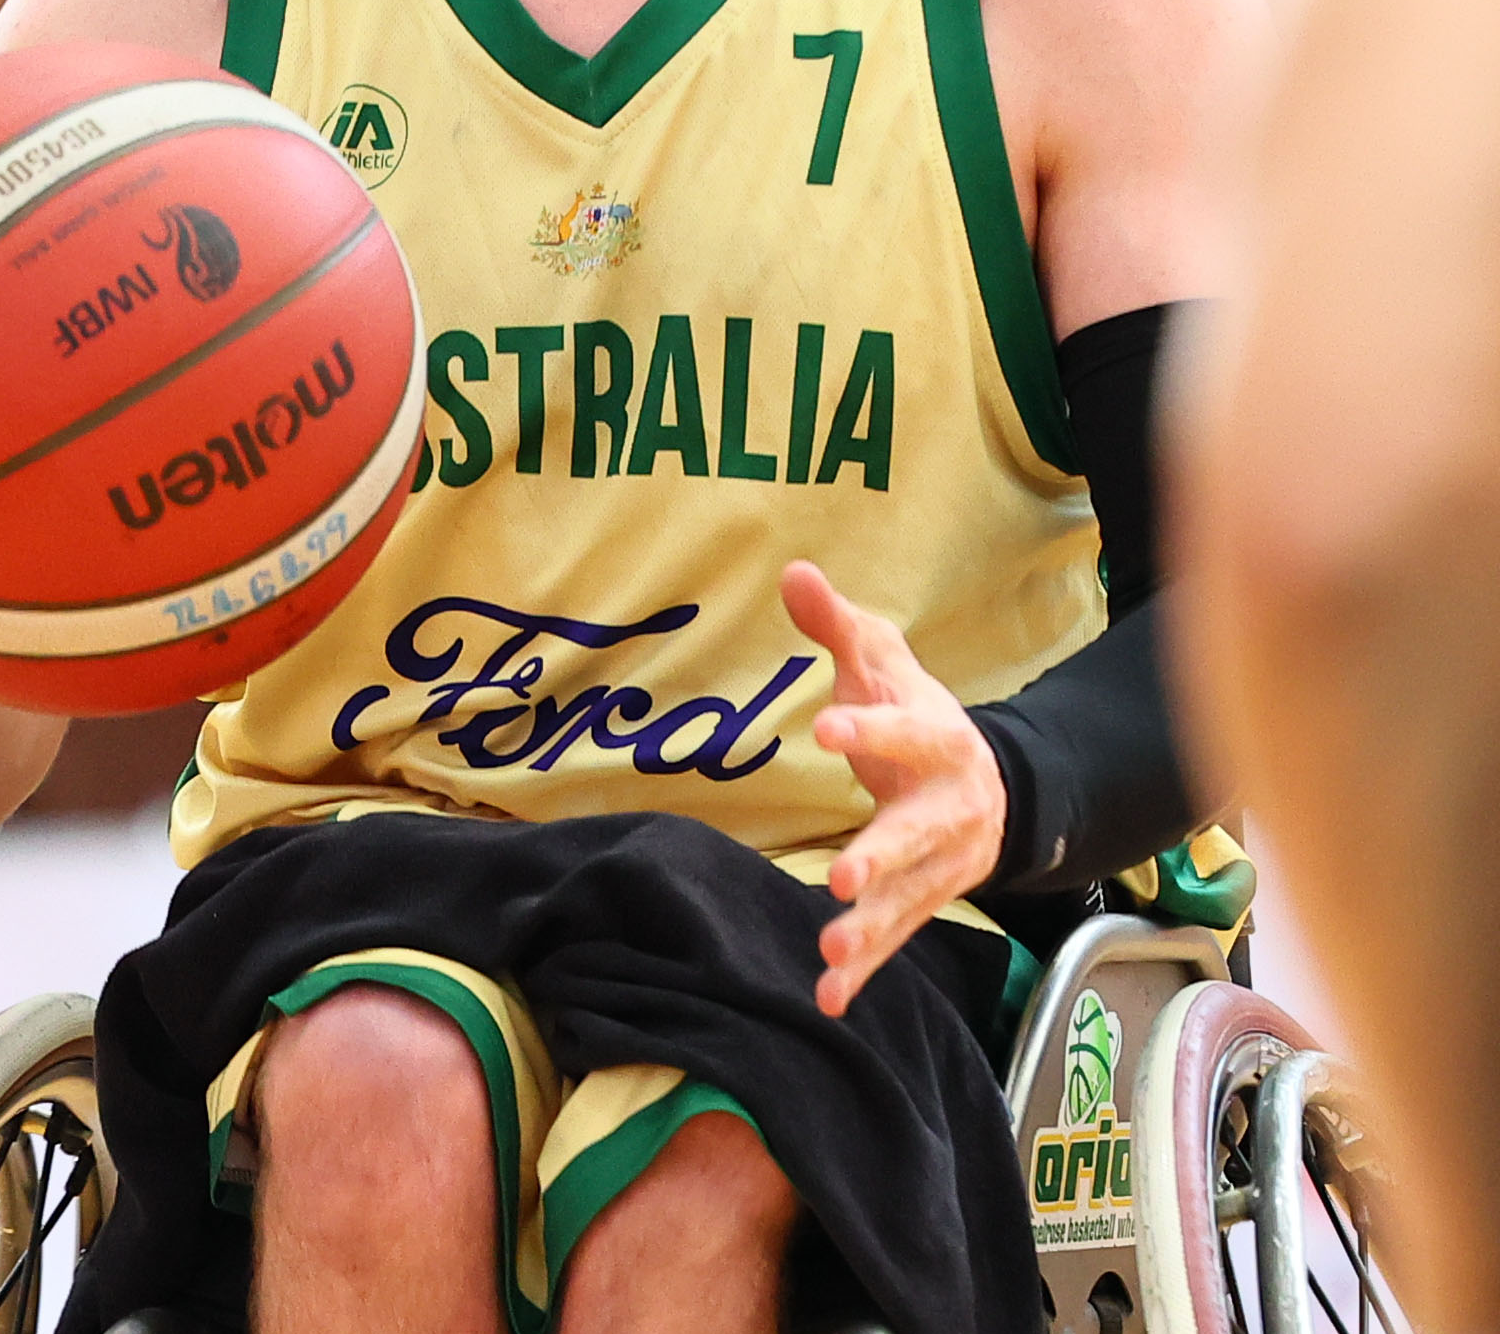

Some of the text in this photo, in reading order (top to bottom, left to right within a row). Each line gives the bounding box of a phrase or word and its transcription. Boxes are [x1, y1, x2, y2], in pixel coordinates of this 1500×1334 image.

[792, 30, 863, 186] 7
[54, 263, 159, 358] IWBF
[107, 338, 355, 530] molten
[412, 314, 895, 493] STRALIA
[331, 596, 818, 782] Ford
[1034, 1114, 1132, 1208] orio
[1067, 1213, 1116, 1243] basketball
